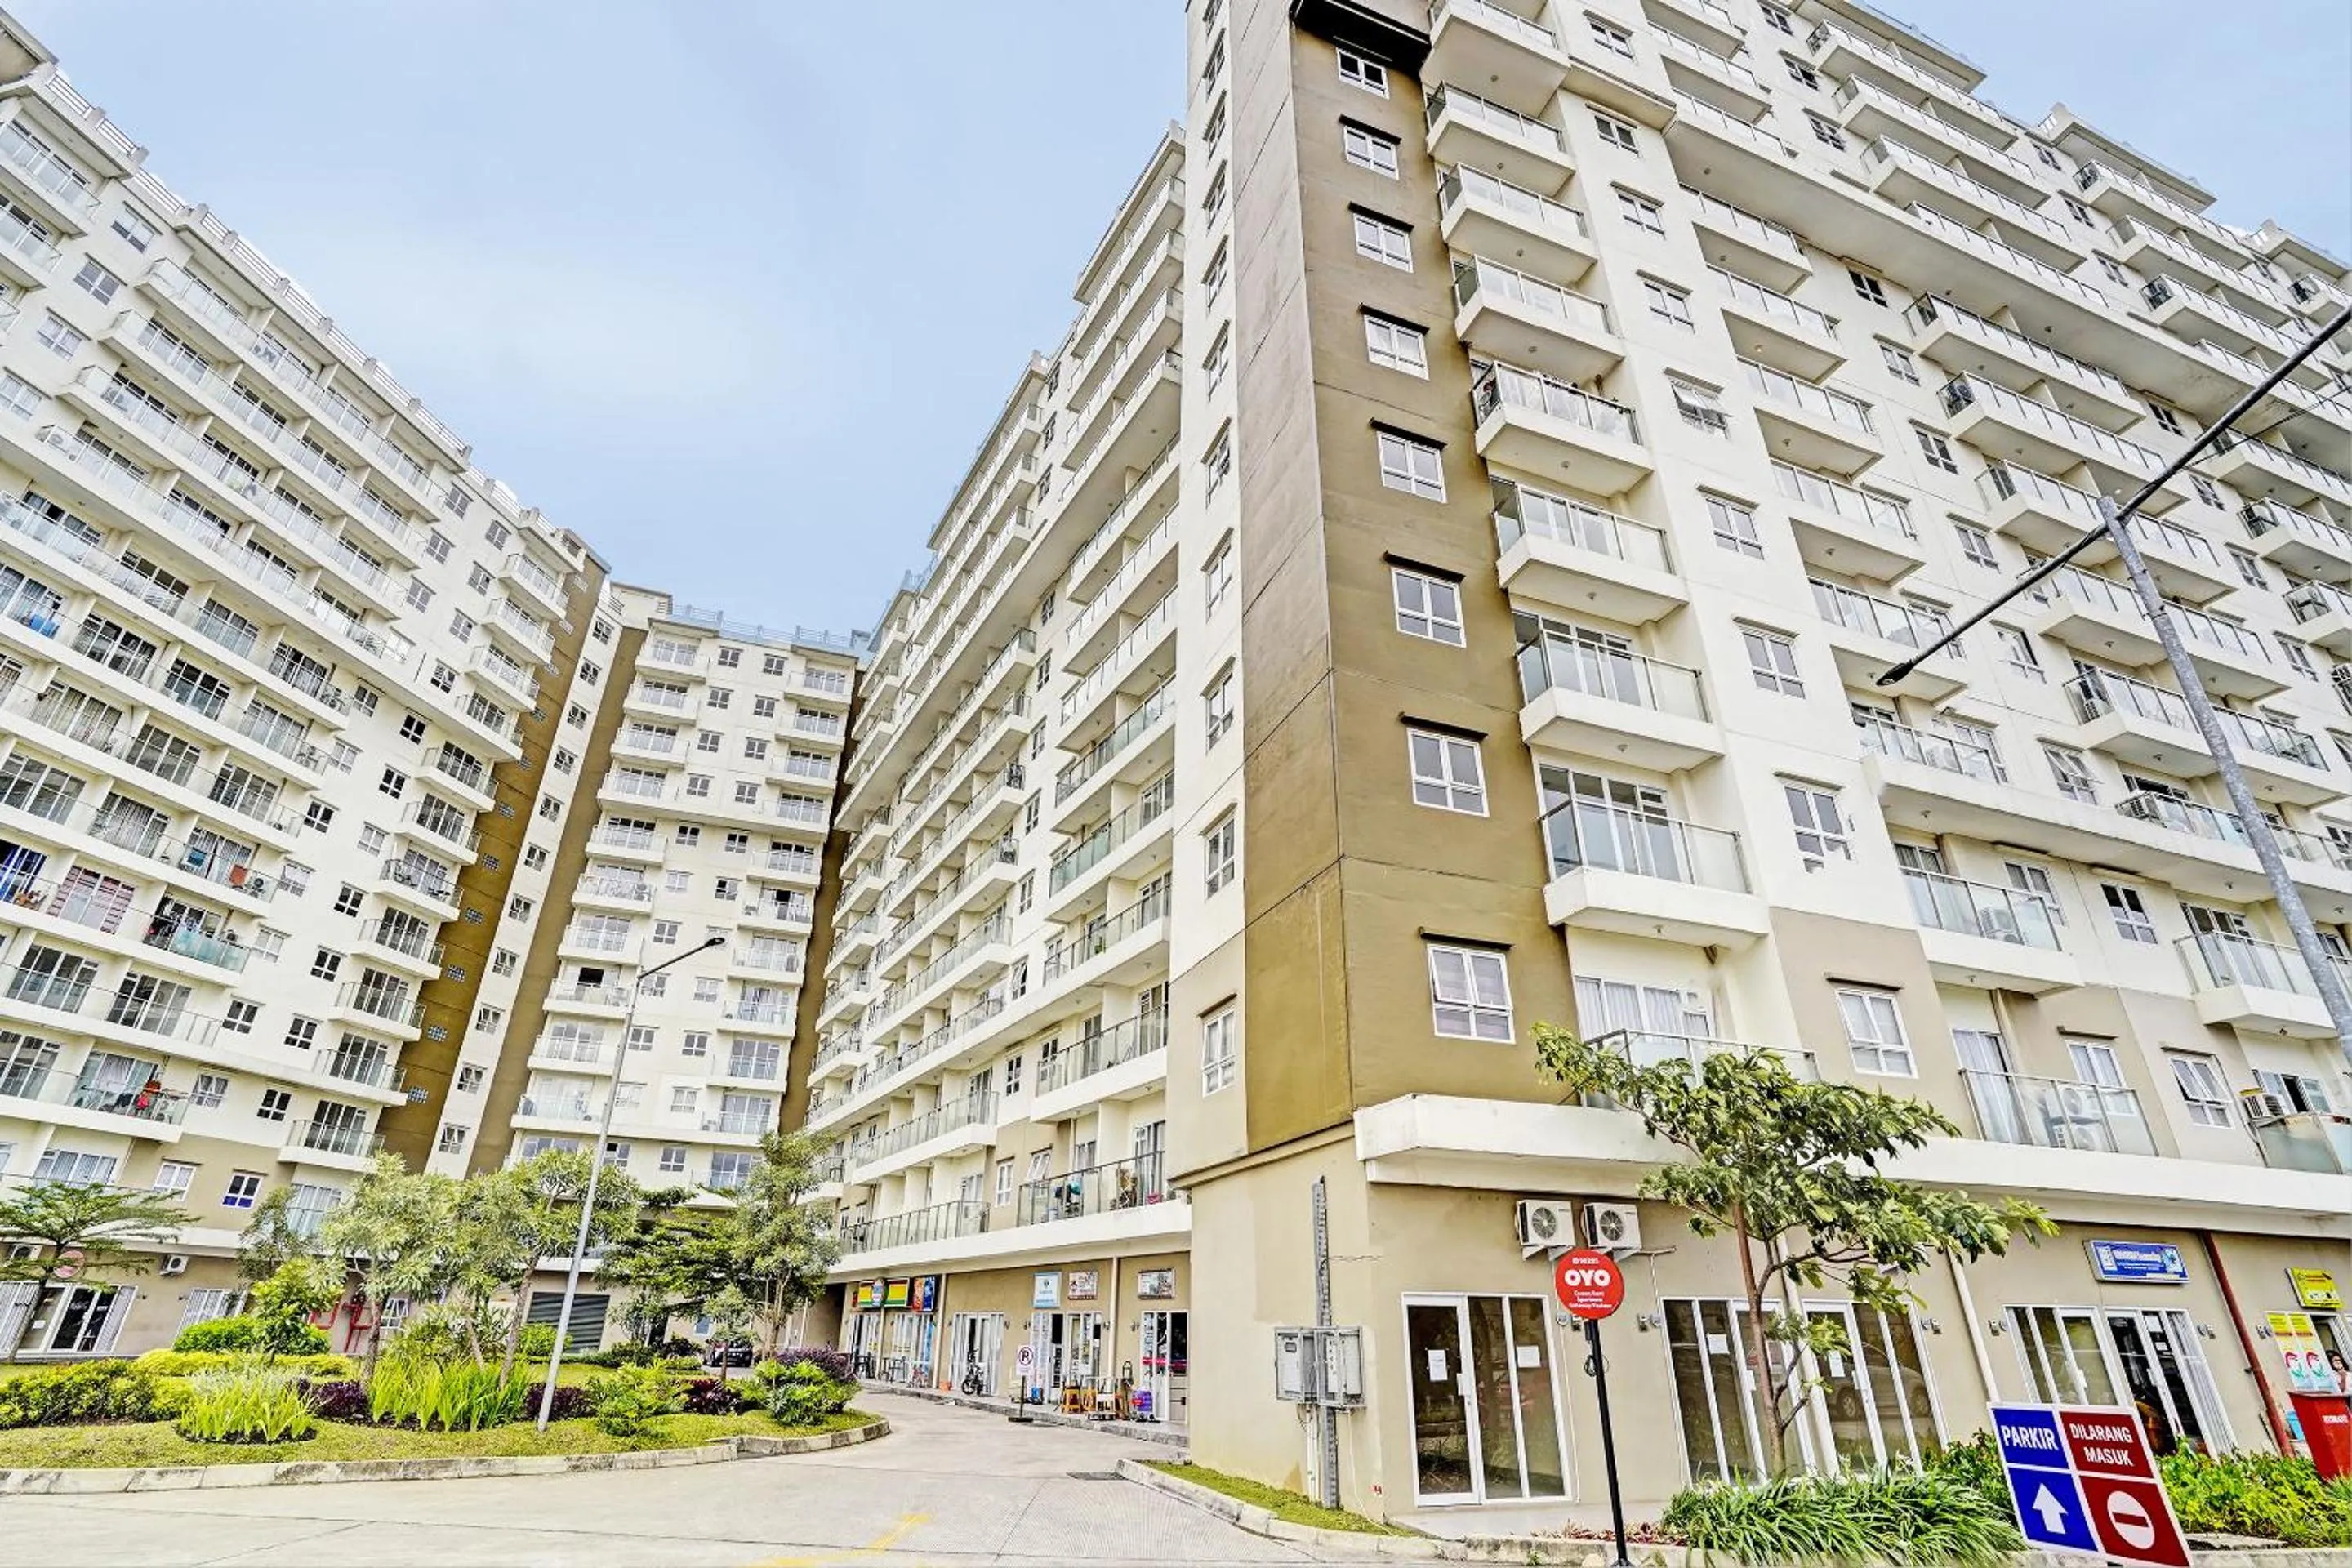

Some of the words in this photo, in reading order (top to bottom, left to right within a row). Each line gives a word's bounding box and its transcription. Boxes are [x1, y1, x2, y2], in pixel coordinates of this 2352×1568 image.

[1565, 1269, 1610, 1286] OYO
[2001, 1425, 2059, 1451] PARKIR
[2069, 1423, 2133, 1443] DILARANG
[2083, 1447, 2134, 1466] MASUK
